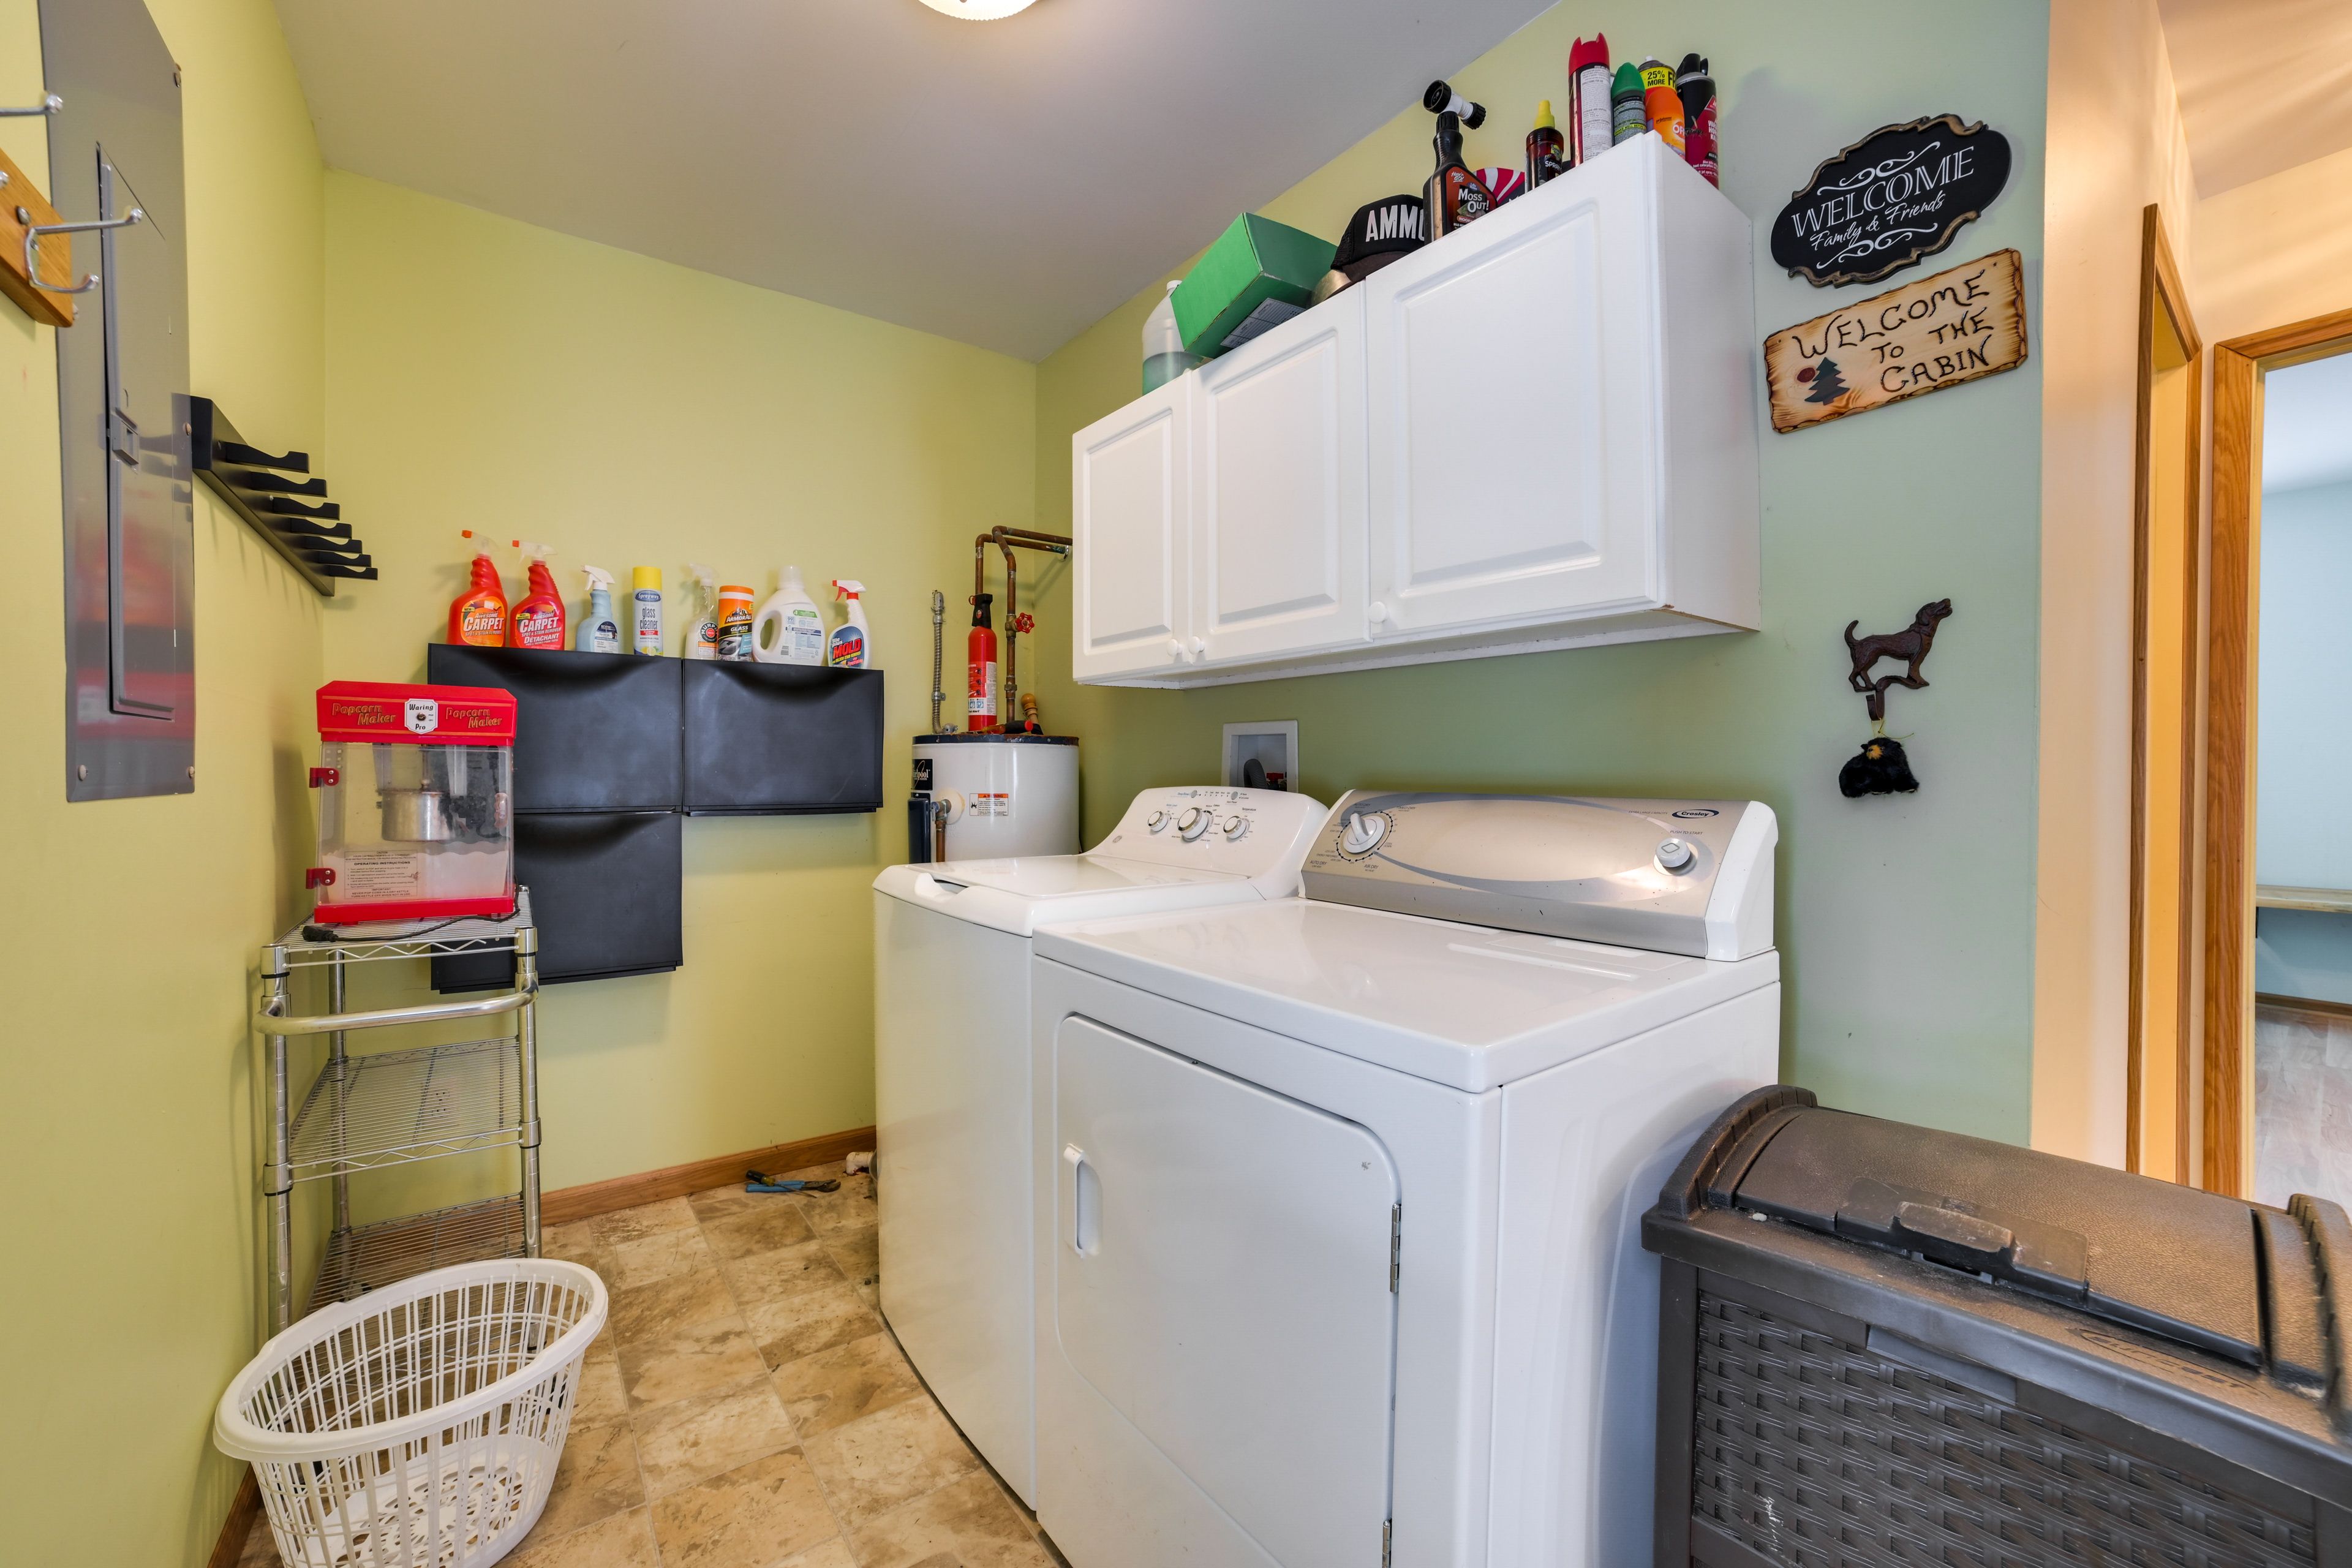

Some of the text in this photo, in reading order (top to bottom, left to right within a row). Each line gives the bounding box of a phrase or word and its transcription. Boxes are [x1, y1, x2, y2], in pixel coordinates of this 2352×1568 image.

[1647, 70, 1665, 80] 25%
[1668, 71, 1676, 88] FR
[1648, 78, 1665, 87] MORE
[1458, 188, 1482, 202] MOSS
[1792, 146, 1975, 238] WELCOME
[1467, 200, 1490, 213] OUT!
[1810, 190, 1946, 251] Family & Friends
[1792, 270, 1990, 360] WELCOME
[1871, 307, 1994, 364] TO THE
[1880, 334, 1992, 393] CABIN
[642, 606, 655, 619] glass
[463, 617, 504, 632] CARPET
[519, 617, 559, 633] CARPET
[639, 619, 658, 630] cleaner
[524, 633, 560, 644] DÉTACHANT
[832, 638, 862, 660] MOLD
[331, 703, 383, 716] Popcorn
[445, 707, 490, 720] Popcorn
[357, 712, 397, 725] Maker
[468, 717, 503, 729] Maker
